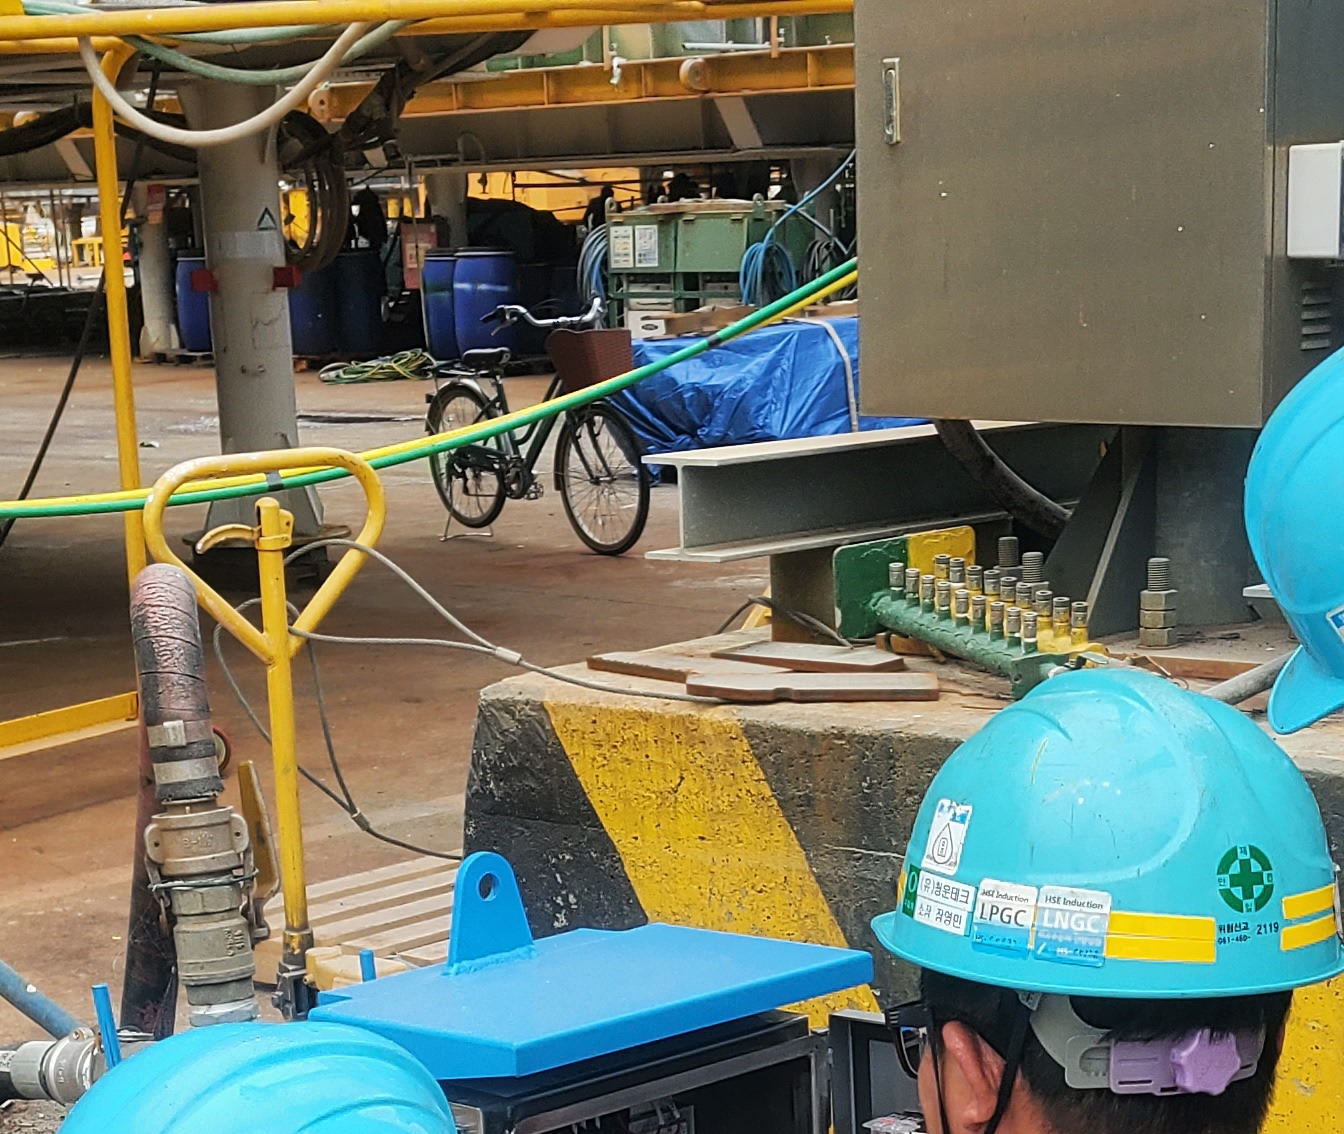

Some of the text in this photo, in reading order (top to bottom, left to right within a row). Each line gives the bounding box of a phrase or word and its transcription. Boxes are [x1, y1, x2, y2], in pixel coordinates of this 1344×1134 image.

[996, 891, 1029, 904] Induction
[1045, 895, 1103, 910] HSE Induction
[979, 902, 1027, 927] LPGC
[1043, 908, 1101, 933] LNGC
[1256, 922, 1279, 935] 2119
